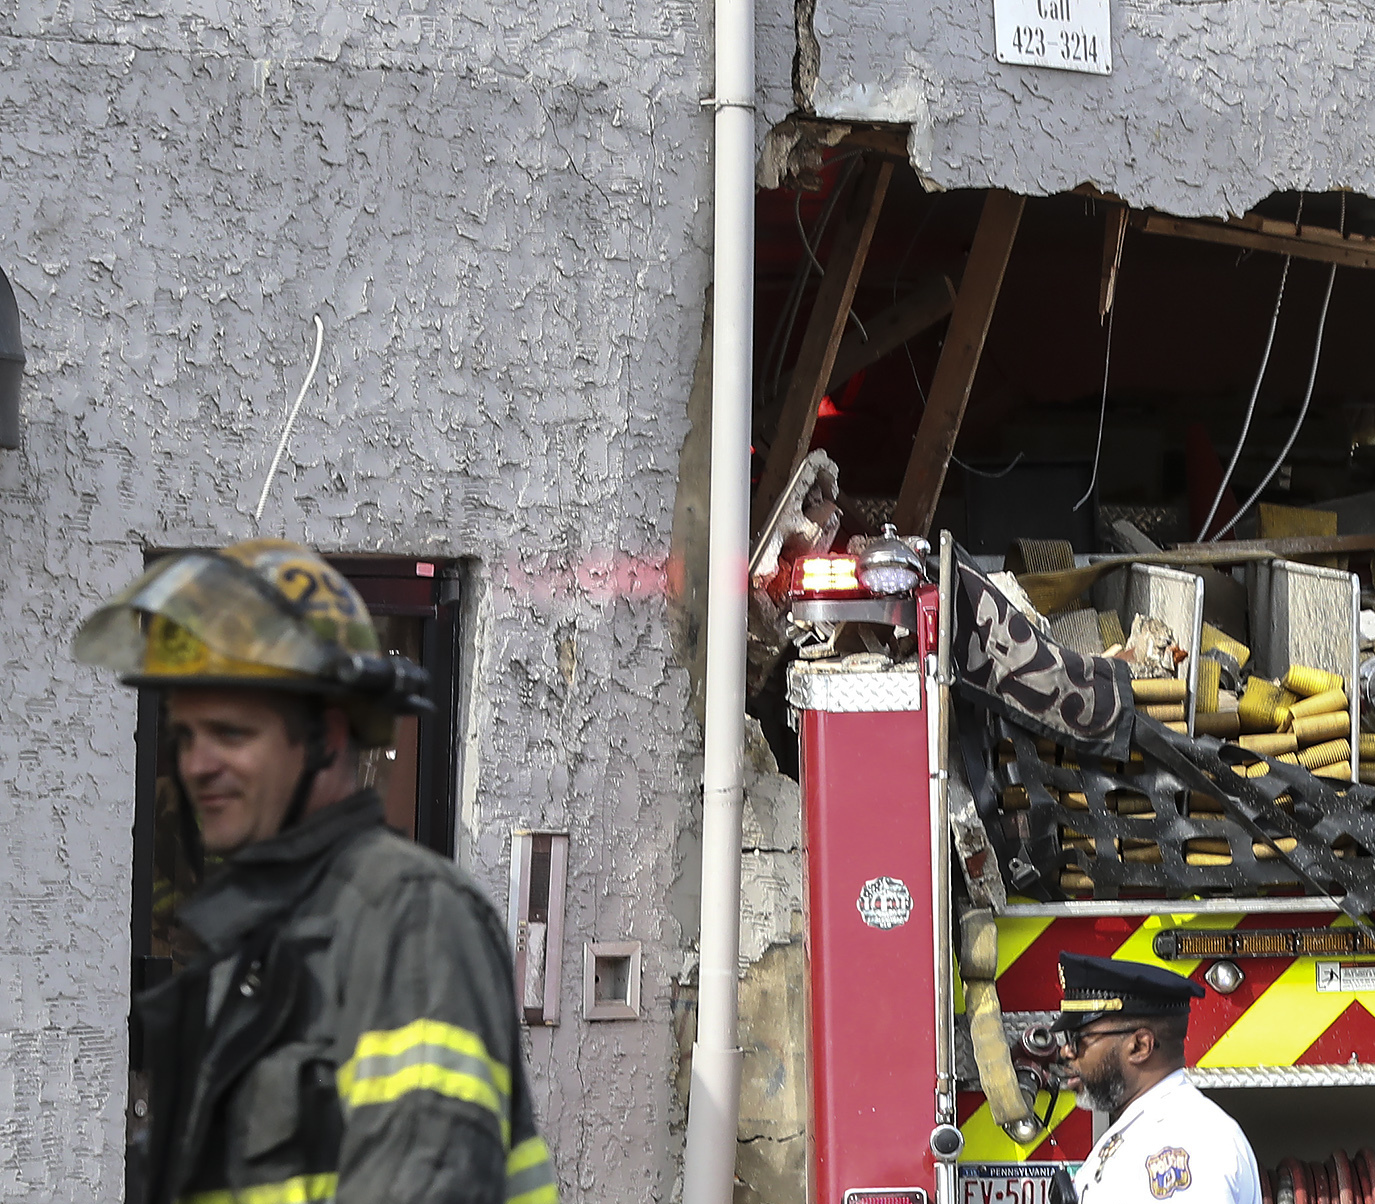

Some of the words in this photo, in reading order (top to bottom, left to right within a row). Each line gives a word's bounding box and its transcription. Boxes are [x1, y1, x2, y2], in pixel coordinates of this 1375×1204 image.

[1037, 0, 1071, 22] Call
[1012, 25, 1098, 62] 423-3214
[990, 1167, 1056, 1177] PENNSYLVANIA
